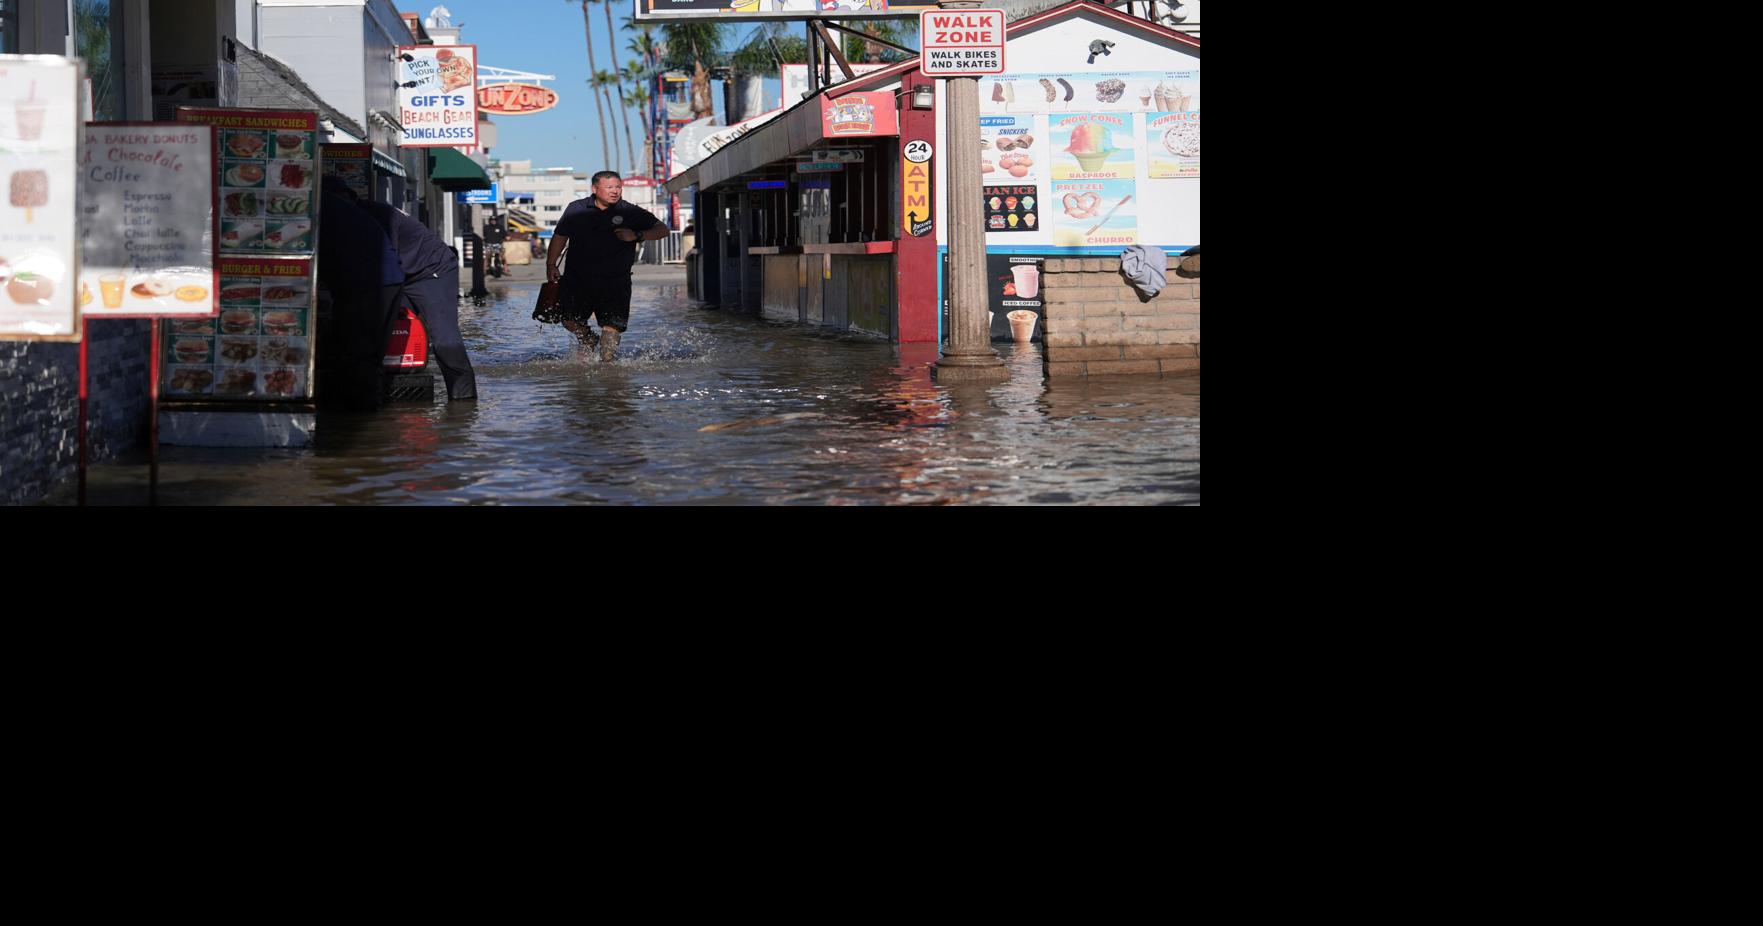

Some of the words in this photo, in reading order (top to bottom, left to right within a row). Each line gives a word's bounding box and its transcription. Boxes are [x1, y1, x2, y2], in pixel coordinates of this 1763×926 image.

[933, 16, 993, 28] WALK
[935, 31, 992, 43] ZONE
[931, 51, 961, 59] WALK
[965, 50, 997, 58] BIKES
[408, 60, 430, 70] PICK
[931, 60, 953, 68] AND
[956, 60, 998, 68] SKATES
[413, 68, 435, 76] YOUR
[436, 65, 457, 74] OWN
[411, 95, 465, 107] GIFTS
[245, 117, 308, 128] SANDWICHES
[404, 109, 440, 125] BEACH
[443, 109, 472, 125] GEAR
[1060, 115, 1088, 127] SNOW
[1090, 115, 1123, 126] CONES
[1153, 113, 1188, 128] FUNNEL
[404, 127, 474, 139] SUNGLASSES
[998, 128, 1029, 136] SNICKERS
[105, 134, 149, 145] BAKERY
[153, 134, 198, 145] DONUTS
[908, 143, 928, 154] 24
[107, 147, 183, 172] Chocolate
[90, 165, 142, 183] Coffee
[907, 165, 926, 207] ATM
[1012, 186, 1036, 195] ICE
[1056, 183, 1105, 191] PRETZEL
[124, 190, 173, 203] Espresso
[222, 264, 261, 274] BURGER
[264, 265, 270, 273] &
[273, 264, 302, 274] FRIES
